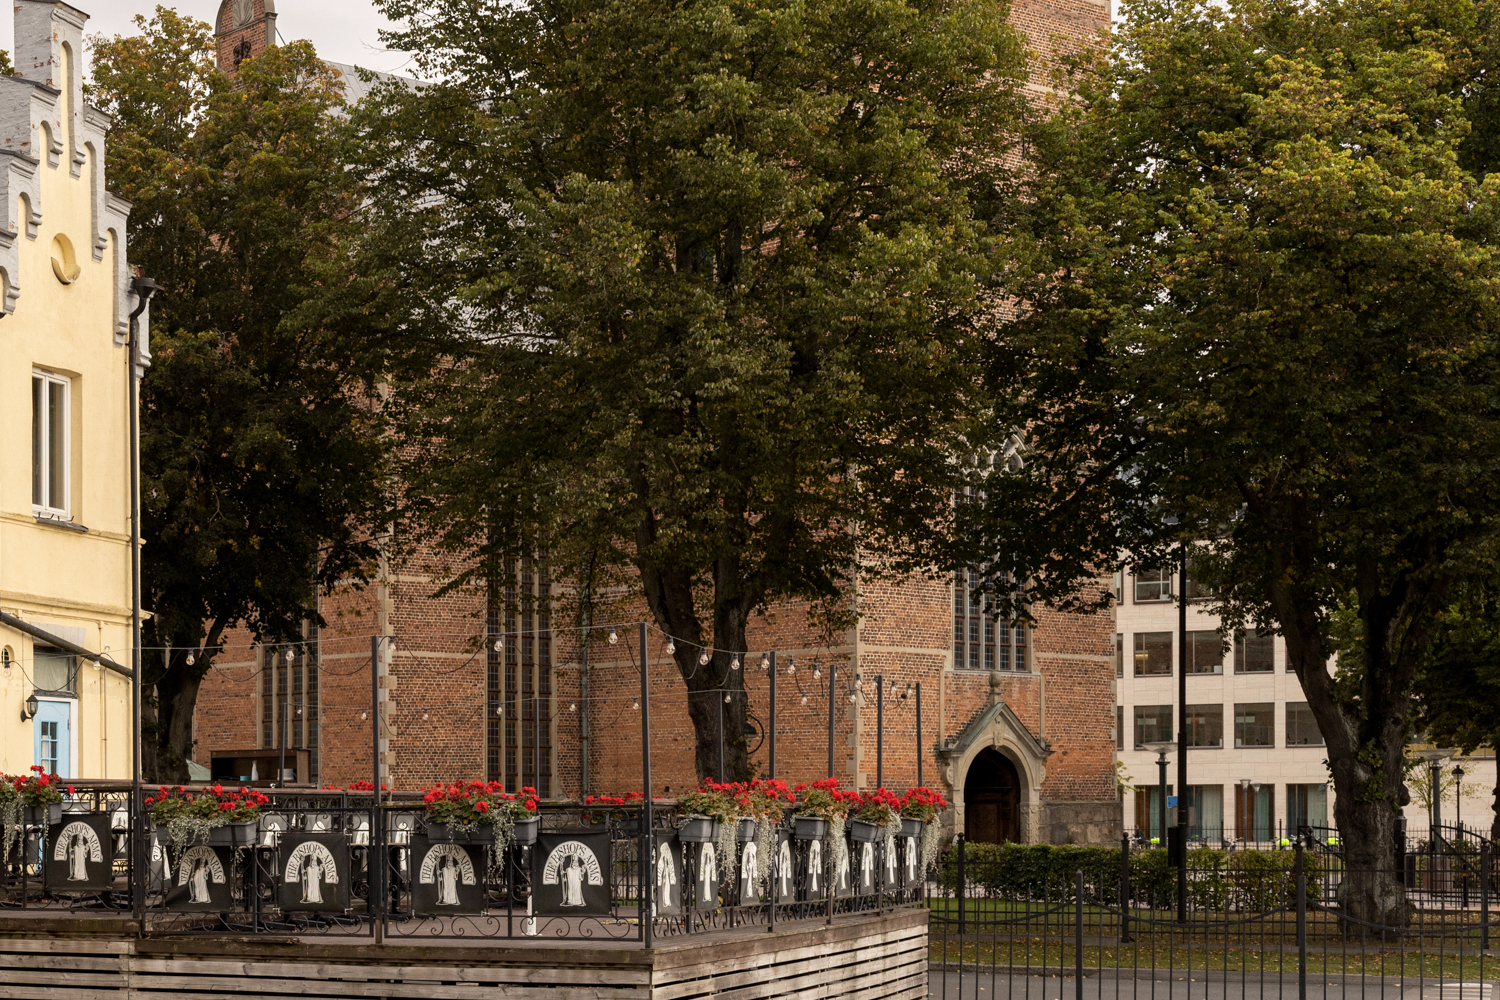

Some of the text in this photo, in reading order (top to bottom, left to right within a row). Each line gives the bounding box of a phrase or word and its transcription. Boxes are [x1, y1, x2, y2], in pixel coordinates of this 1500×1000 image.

[56, 823, 100, 859] THE BISHOPS ARMS
[180, 847, 222, 882] THE BISHOPS ARMS
[287, 843, 336, 880] THE BISHOPS ARMS
[422, 844, 473, 882] THE BISHOPS ARMS
[545, 843, 600, 882] THE BISHOPS ARMS
